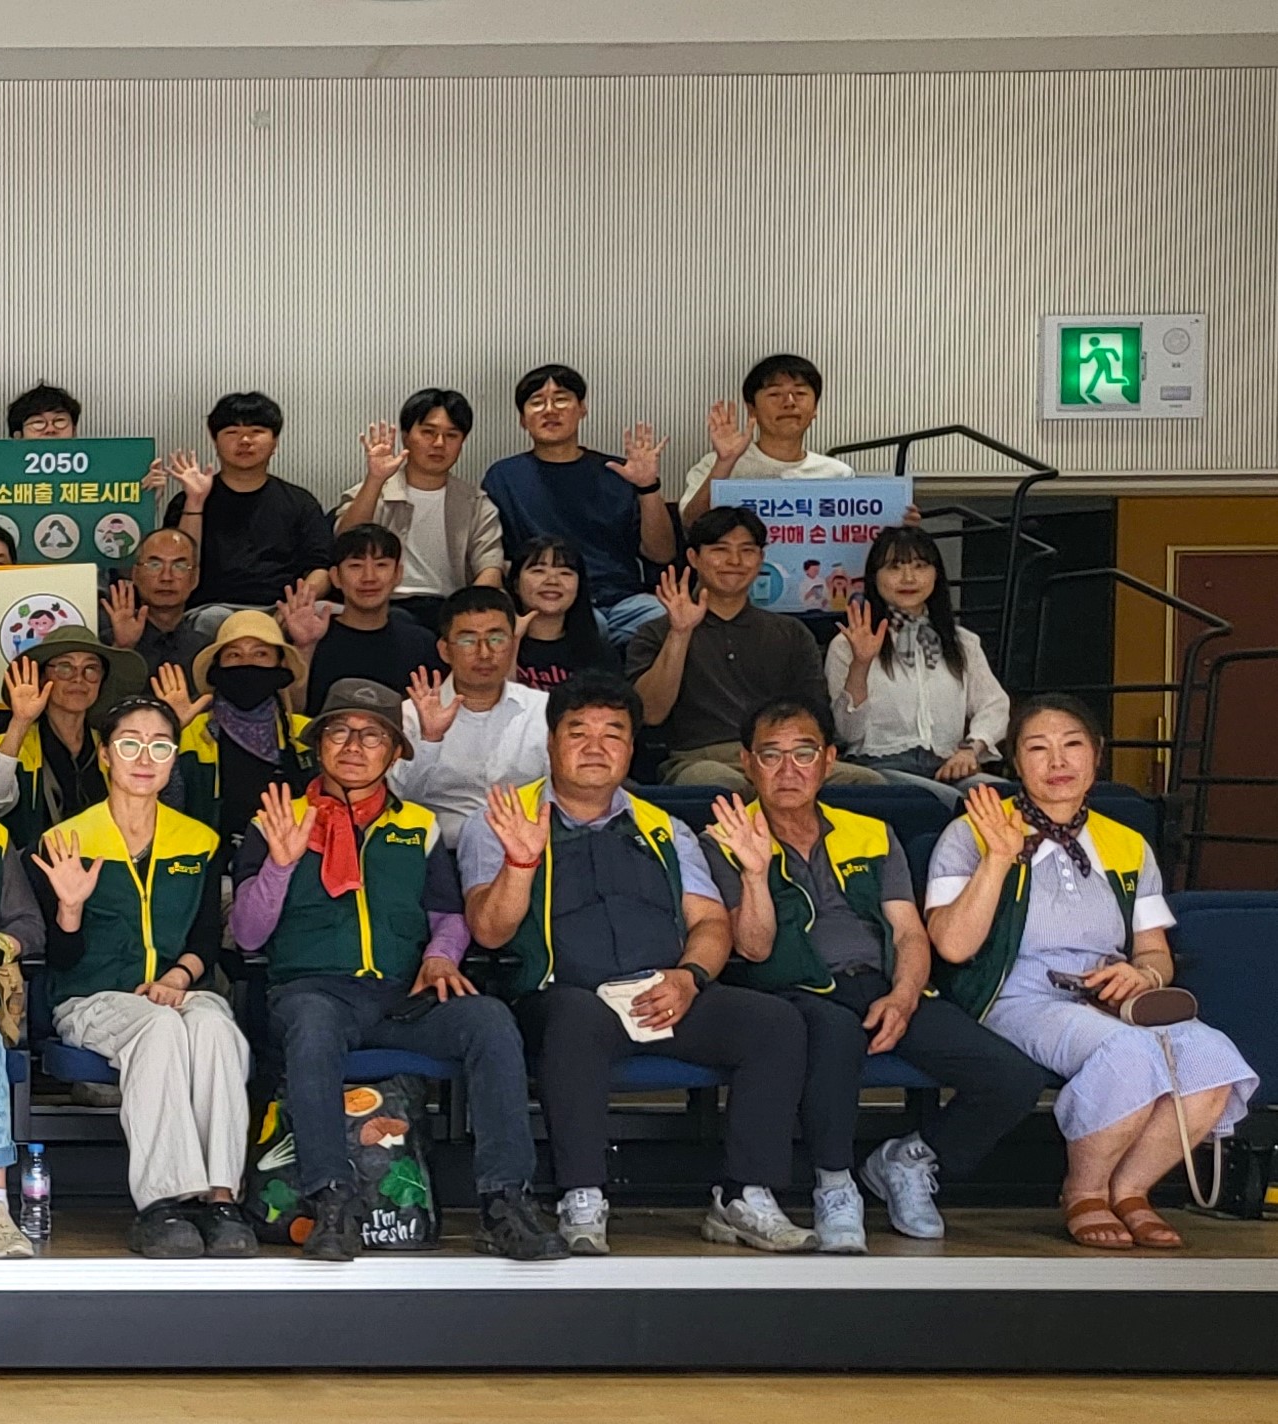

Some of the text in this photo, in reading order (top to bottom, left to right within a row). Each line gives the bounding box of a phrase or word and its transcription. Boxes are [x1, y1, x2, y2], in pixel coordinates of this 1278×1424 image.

[24, 452, 89, 474] 2050
[59, 481, 141, 504] 제로시대
[810, 524, 827, 544] 손
[832, 524, 881, 543] 내밀G
[371, 1209, 396, 1229] I'm
[360, 1218, 418, 1247] fresh!
